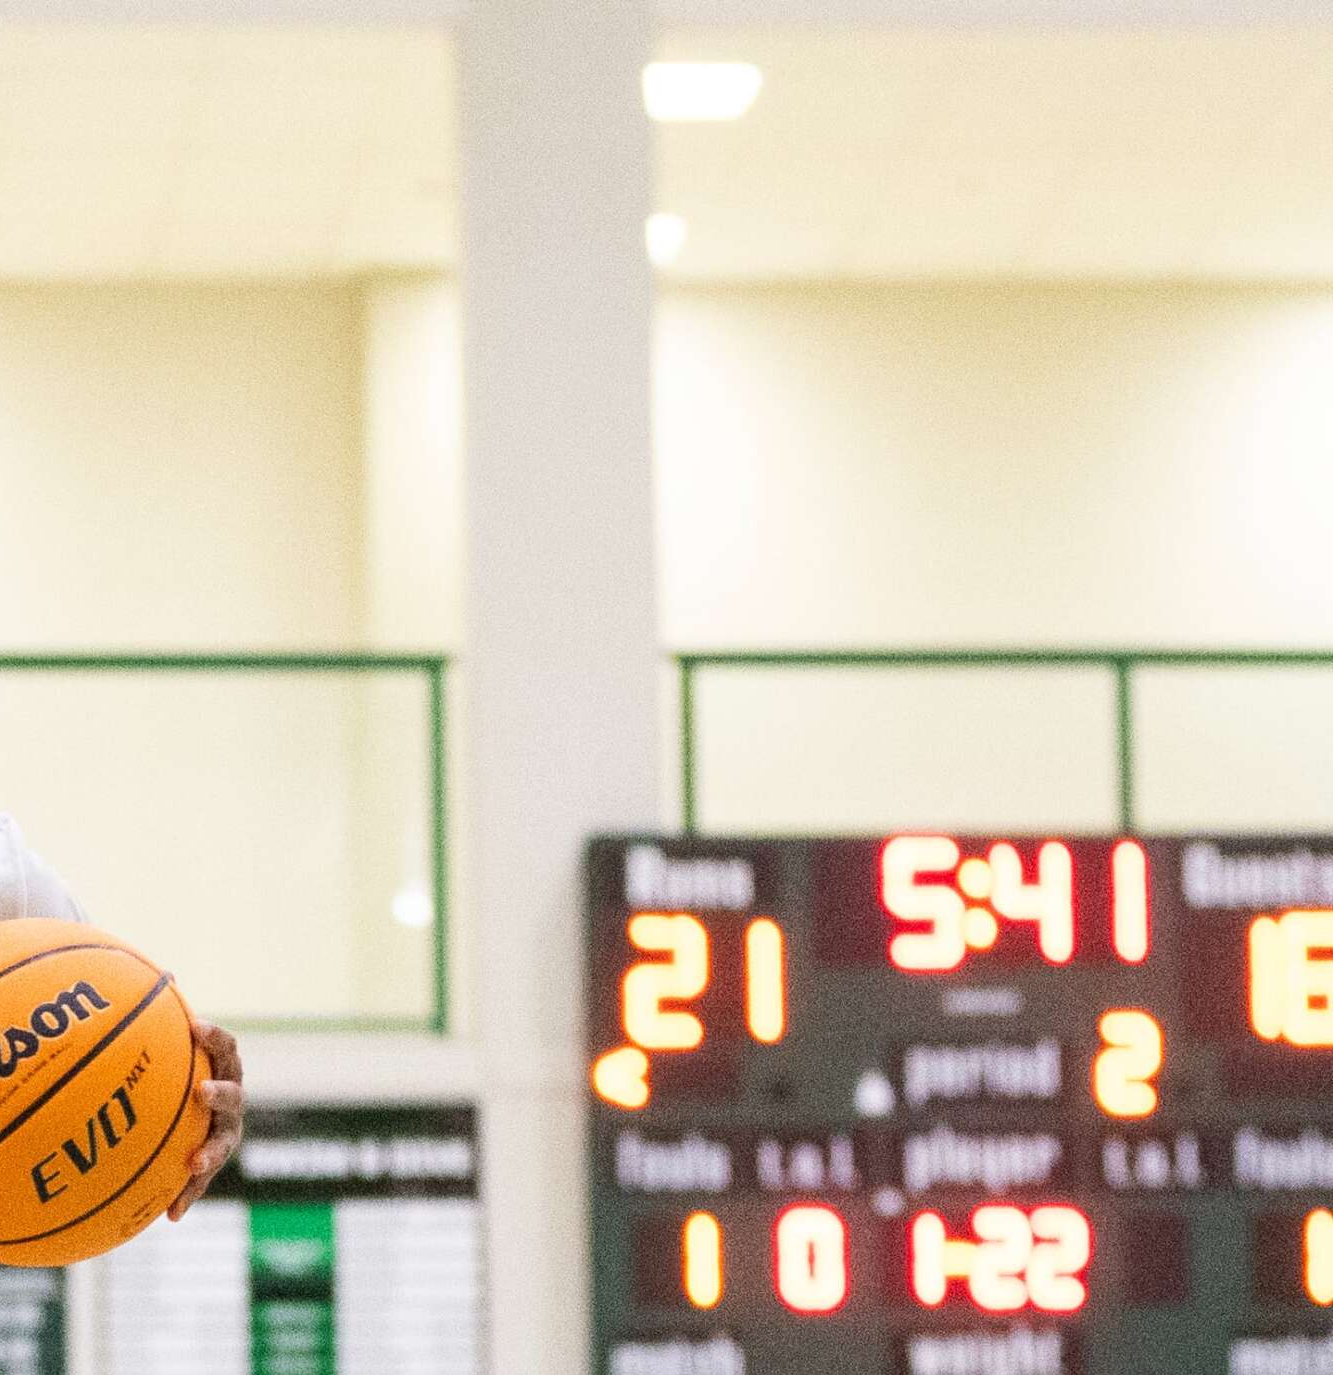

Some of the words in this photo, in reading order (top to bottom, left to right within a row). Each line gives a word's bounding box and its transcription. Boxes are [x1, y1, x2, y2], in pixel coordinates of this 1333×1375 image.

[878, 833, 1151, 973] 5:41
[622, 909, 789, 1051] 21
[1091, 1008, 1165, 1121] 2
[680, 1209, 724, 1310] 1
[774, 1203, 851, 1315] 0
